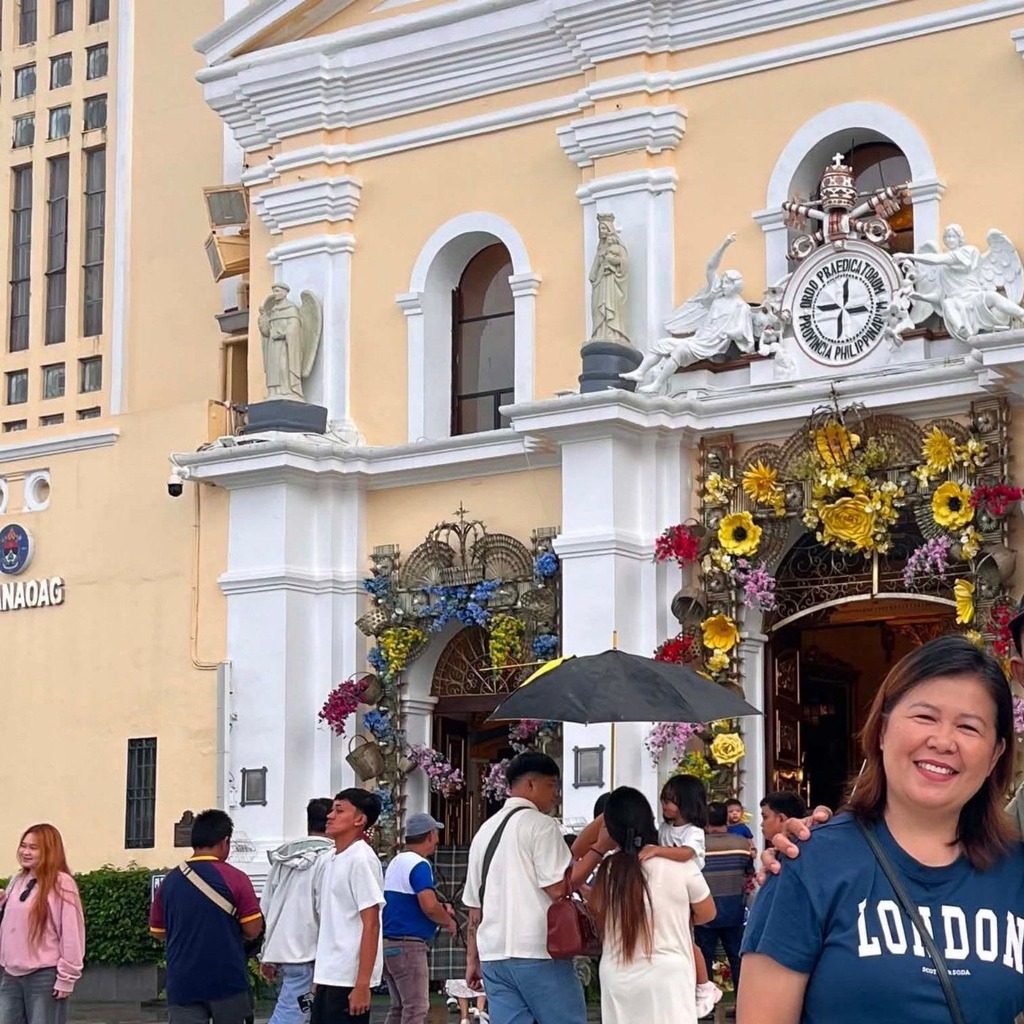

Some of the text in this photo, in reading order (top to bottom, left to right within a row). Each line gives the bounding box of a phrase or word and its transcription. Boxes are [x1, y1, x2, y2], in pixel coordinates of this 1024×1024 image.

[800, 258, 886, 308] ORDO PRAEDICATORUM
[799, 314, 831, 359] PROVINCIA
[0, 576, 63, 611] NAOAG
